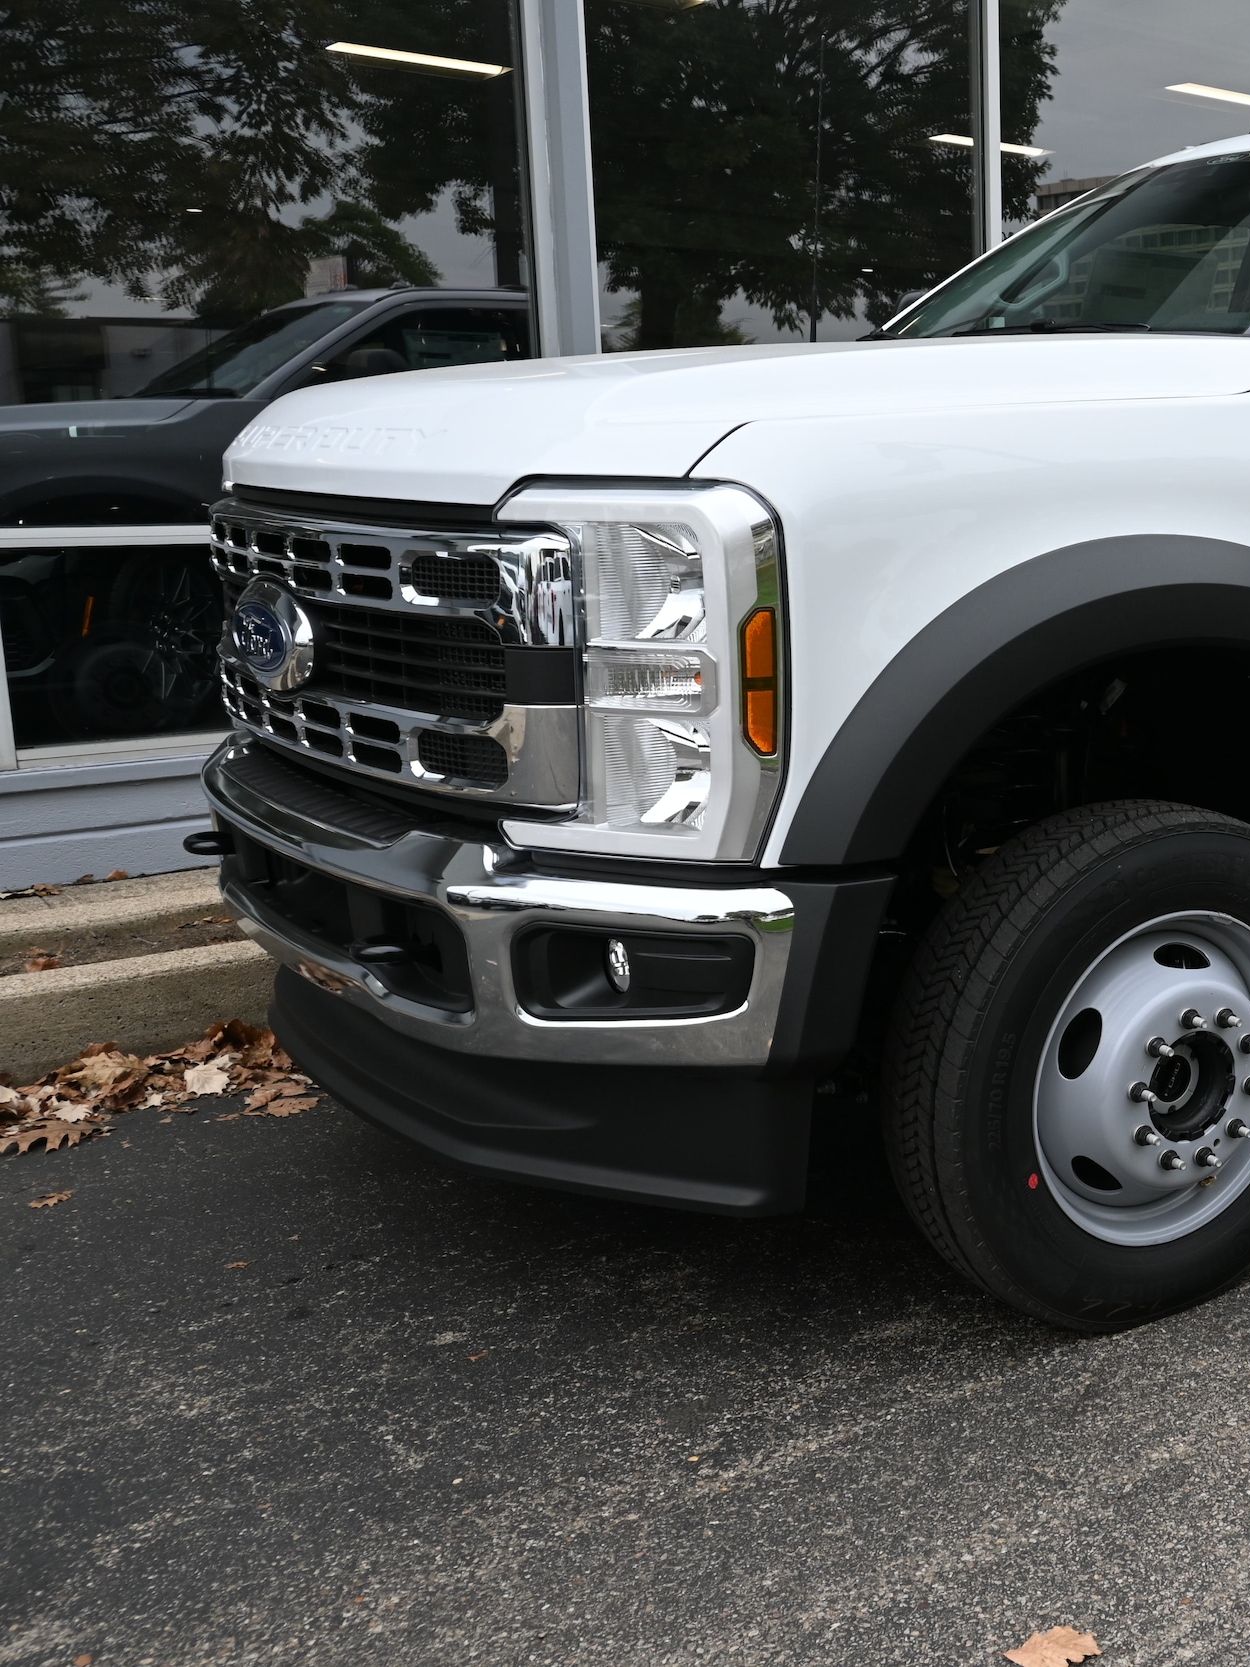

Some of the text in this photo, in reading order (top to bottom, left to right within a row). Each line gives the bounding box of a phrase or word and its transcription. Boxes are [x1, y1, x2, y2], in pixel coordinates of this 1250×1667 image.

[311, 427, 448, 457] DUTY
[987, 1032, 1016, 1152] 225/70 R 19.5
